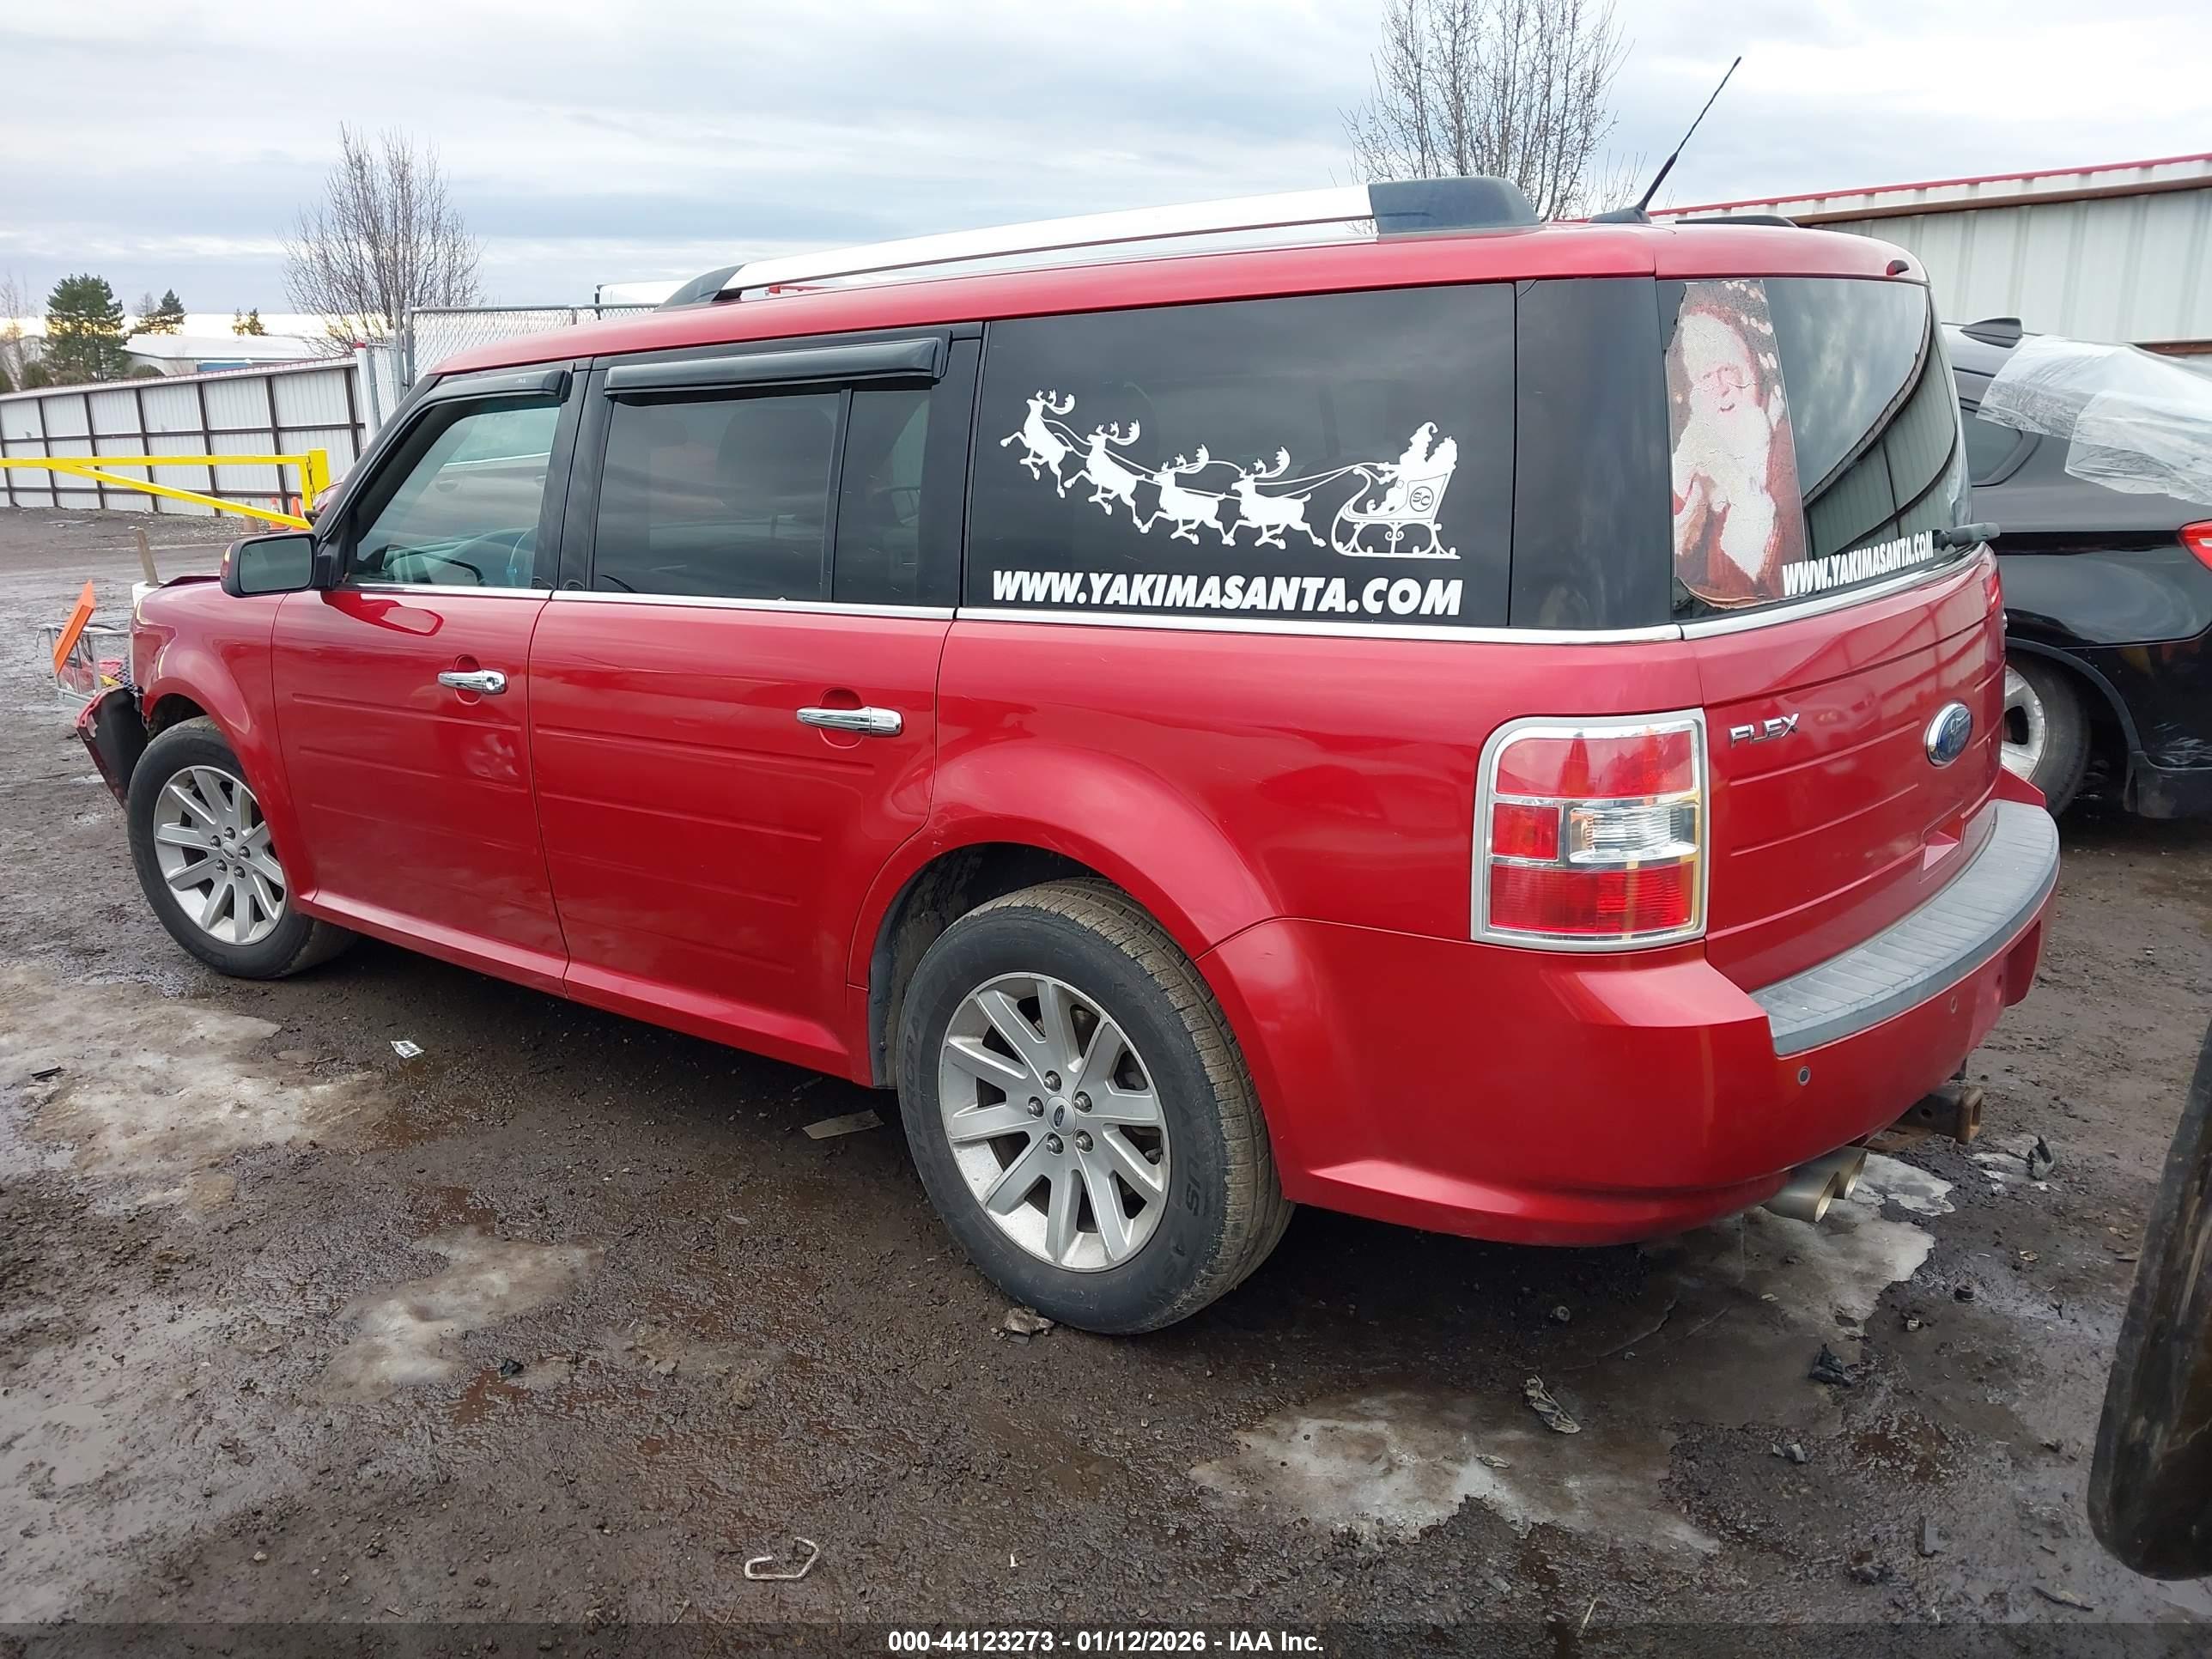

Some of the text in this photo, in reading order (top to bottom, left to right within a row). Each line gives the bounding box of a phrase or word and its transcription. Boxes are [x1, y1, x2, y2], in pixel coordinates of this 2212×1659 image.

[1413, 492, 1431, 506] SC
[1782, 530, 1934, 597] WWW.YAKIMASANTA.COM
[993, 570, 1463, 616] WWW.YAKIMASANTA.COM
[1729, 712, 1800, 749] FLEX
